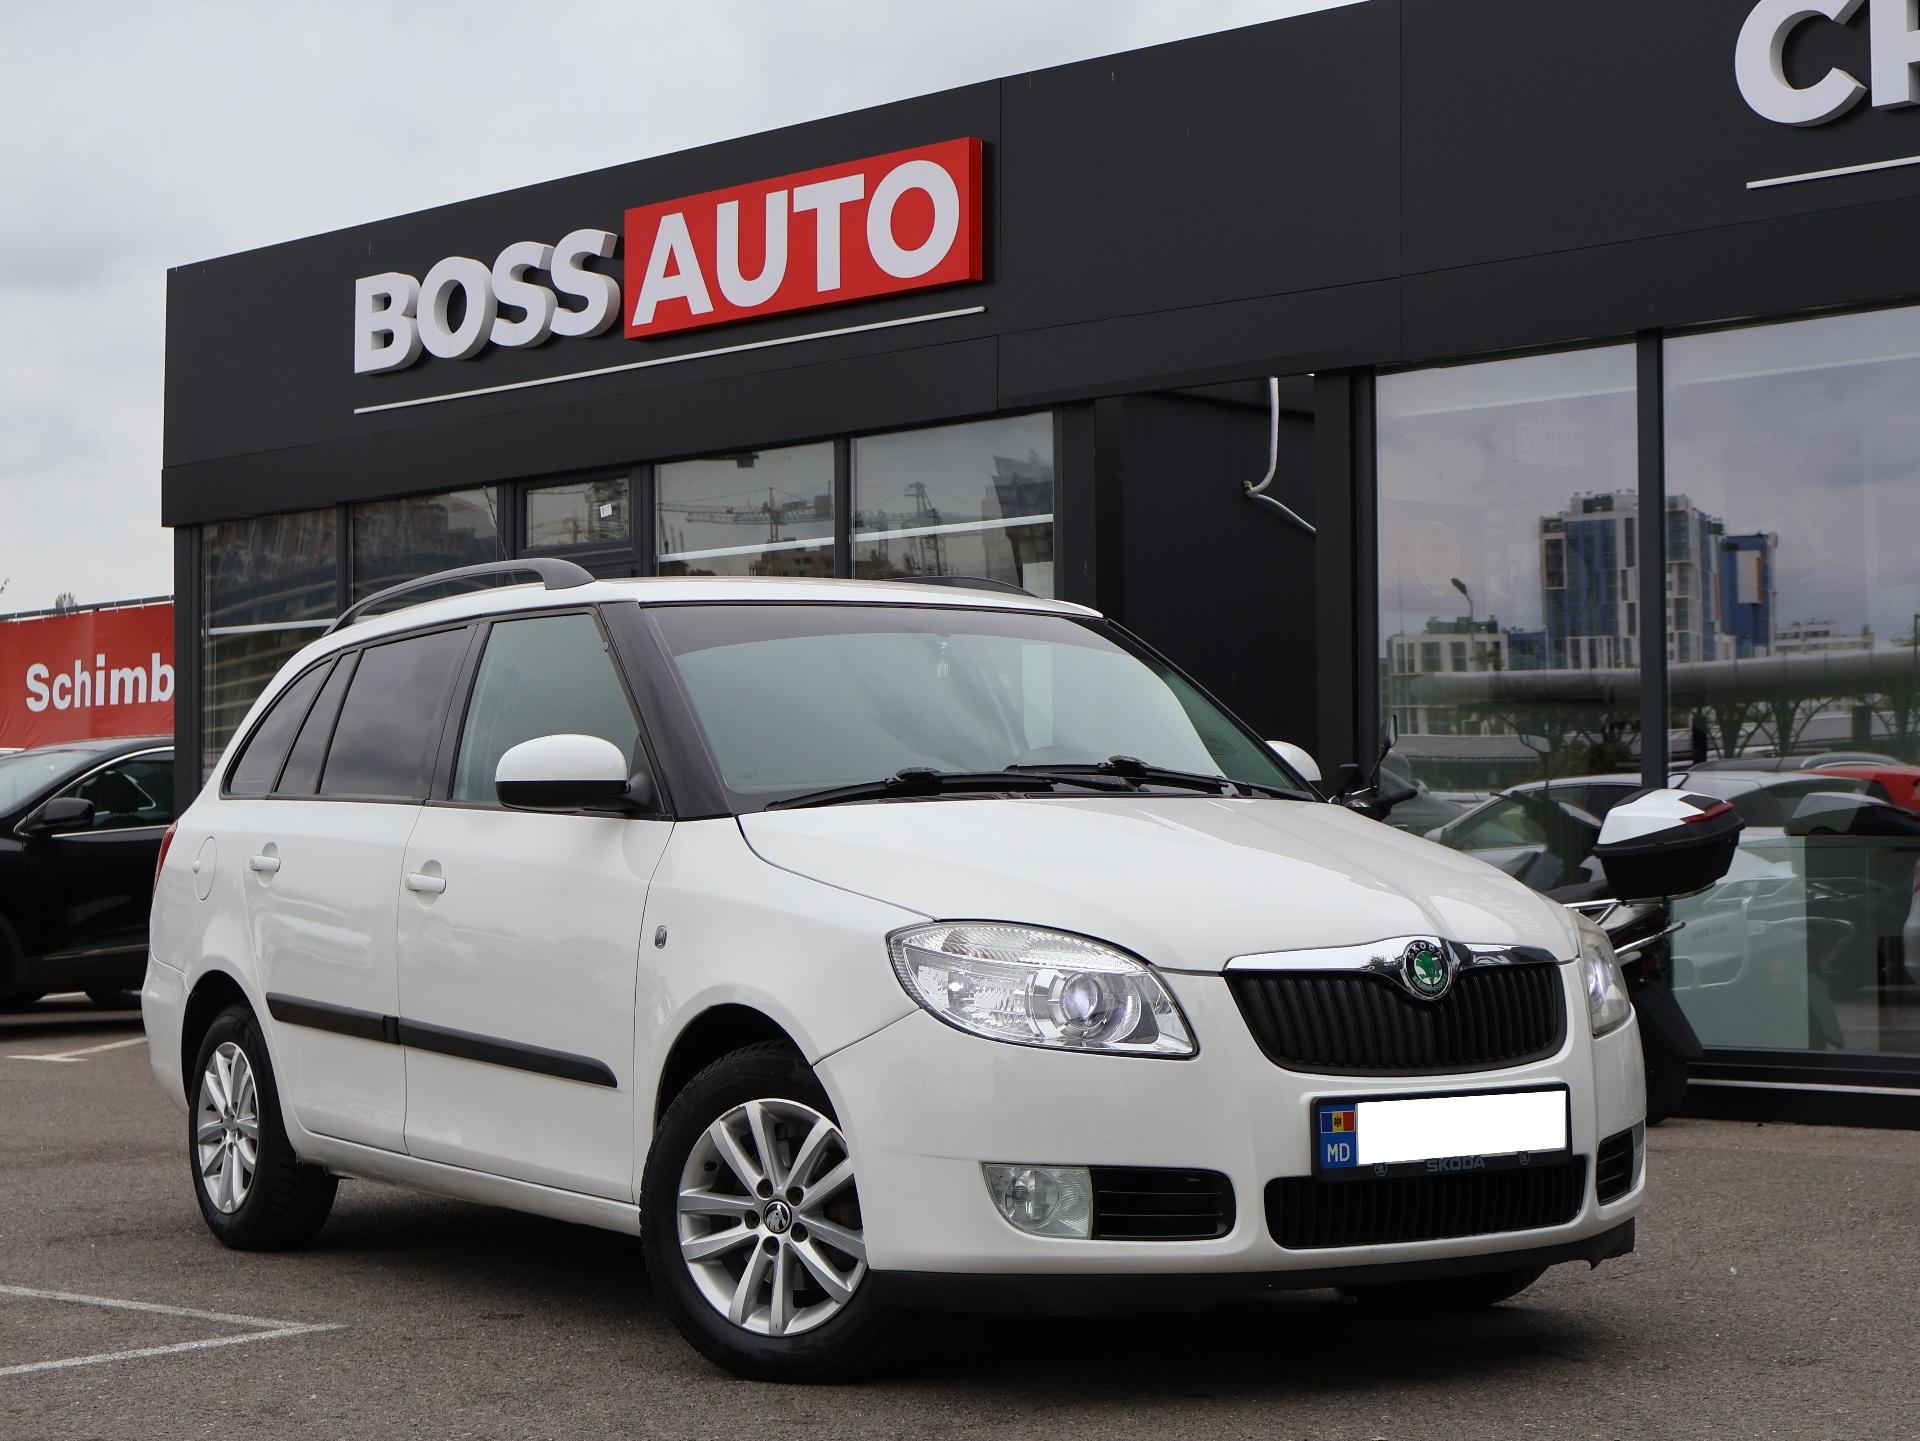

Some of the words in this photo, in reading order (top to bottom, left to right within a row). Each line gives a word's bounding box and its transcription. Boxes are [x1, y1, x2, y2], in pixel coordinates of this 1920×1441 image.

[354, 228, 621, 375] BOSS
[631, 159, 960, 327] AUTO
[26, 652, 175, 713] Schimb
[1327, 1143, 1351, 1163] MD
